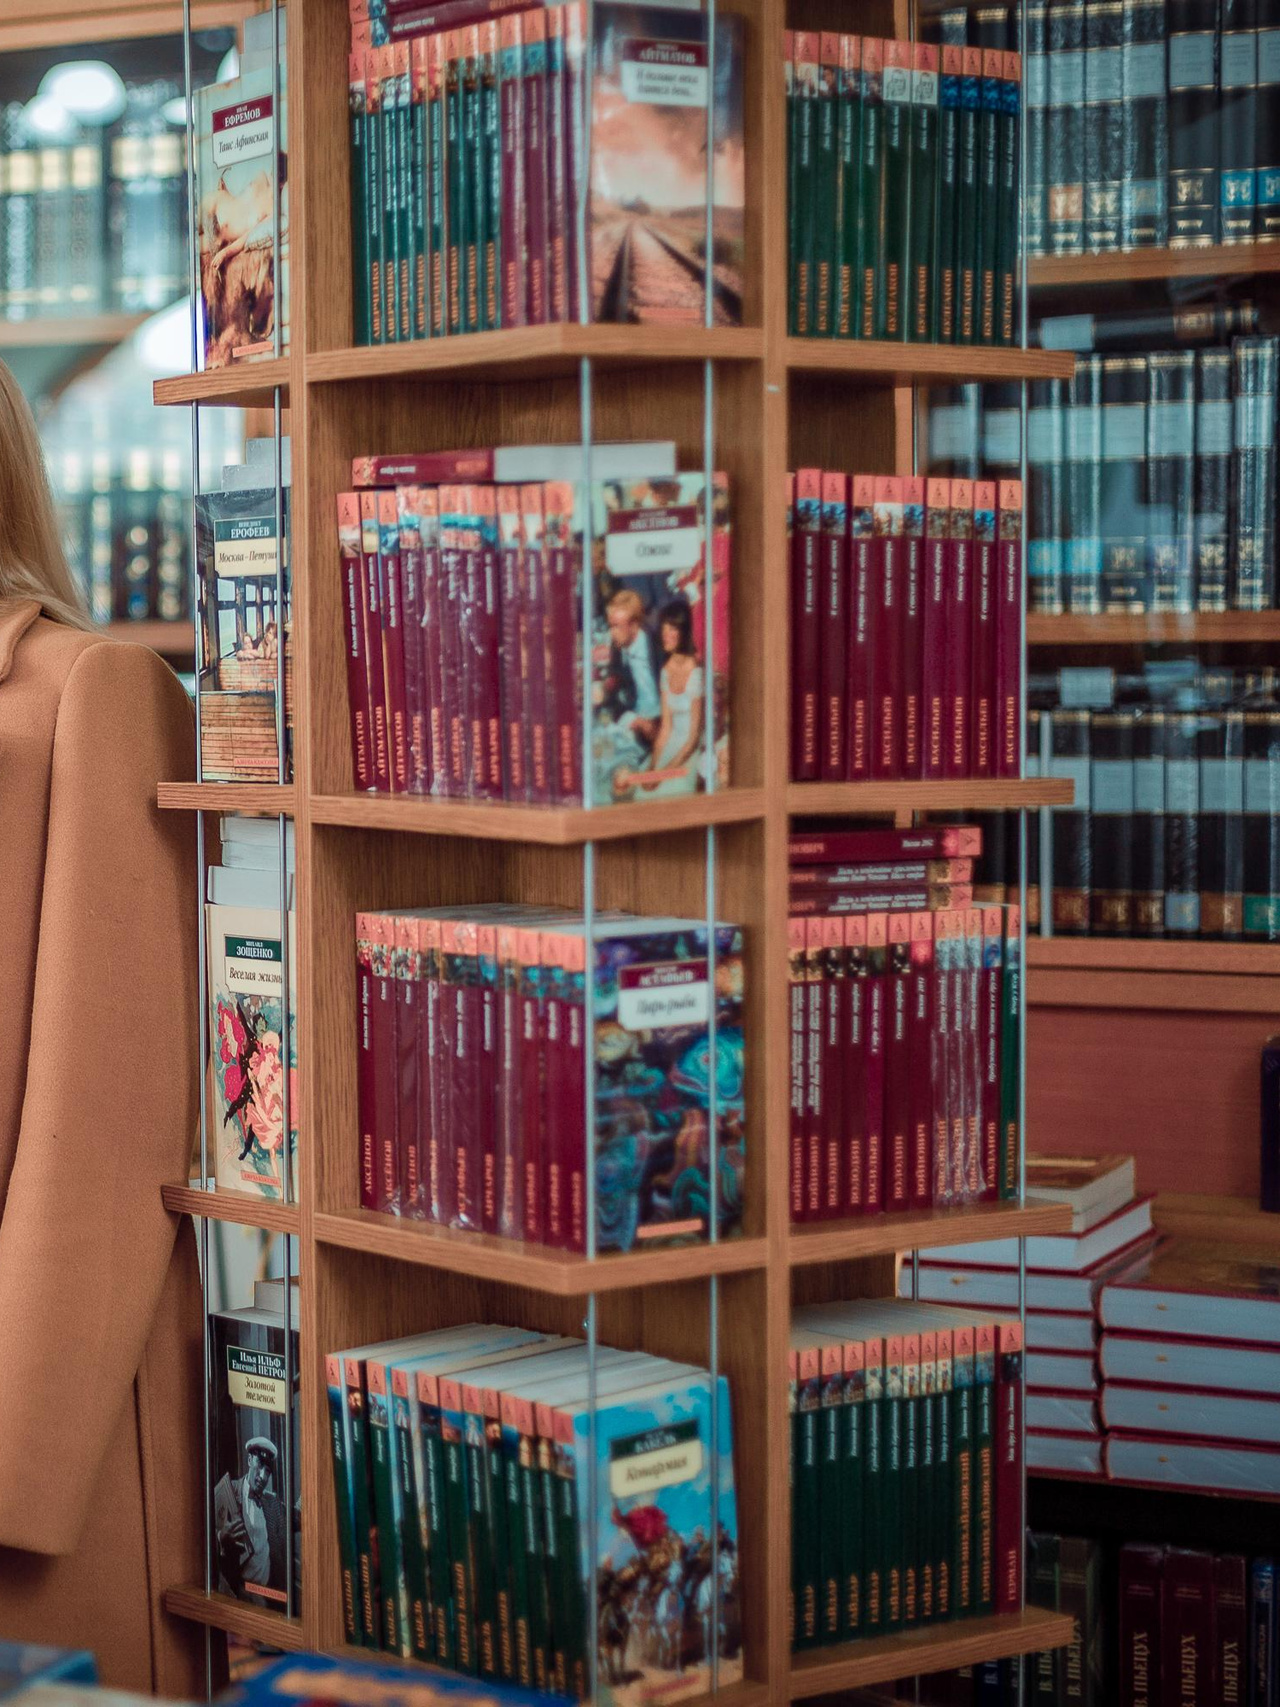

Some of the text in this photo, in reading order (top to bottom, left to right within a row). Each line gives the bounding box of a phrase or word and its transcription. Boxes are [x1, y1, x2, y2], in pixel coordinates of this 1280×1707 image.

[224, 108, 261, 127] ЕФРЕМОВ
[219, 131, 269, 153] Таис Афинская
[231, 526, 270, 539] ЕРОФЕЕВ
[219, 552, 244, 563] Москва
[355, 711, 367, 781] АЙТМАТОВ
[375, 706, 386, 778] АЙТМАТОВ
[395, 712, 406, 783] АЙТМАТОВ
[236, 946, 273, 959] ЗОЩЕНКО
[229, 966, 256, 981] Веселая
[363, 1134, 372, 1194] АКСЁНОВ
[232, 1359, 257, 1374] Евгений
[240, 1352, 281, 1368] Илья ИЛЬФ
[244, 1376, 276, 1393] Золотой
[245, 1391, 276, 1405] теленок
[625, 1457, 688, 1482] Конармия
[1007, 1550, 1017, 1601] ГЕРМАН
[1133, 1631, 1151, 1692] ПЬЕЦУХ
[1181, 1635, 1199, 1695] ПЬЕЦУХ
[1223, 1641, 1240, 1702] ПЬЕЦУХ
